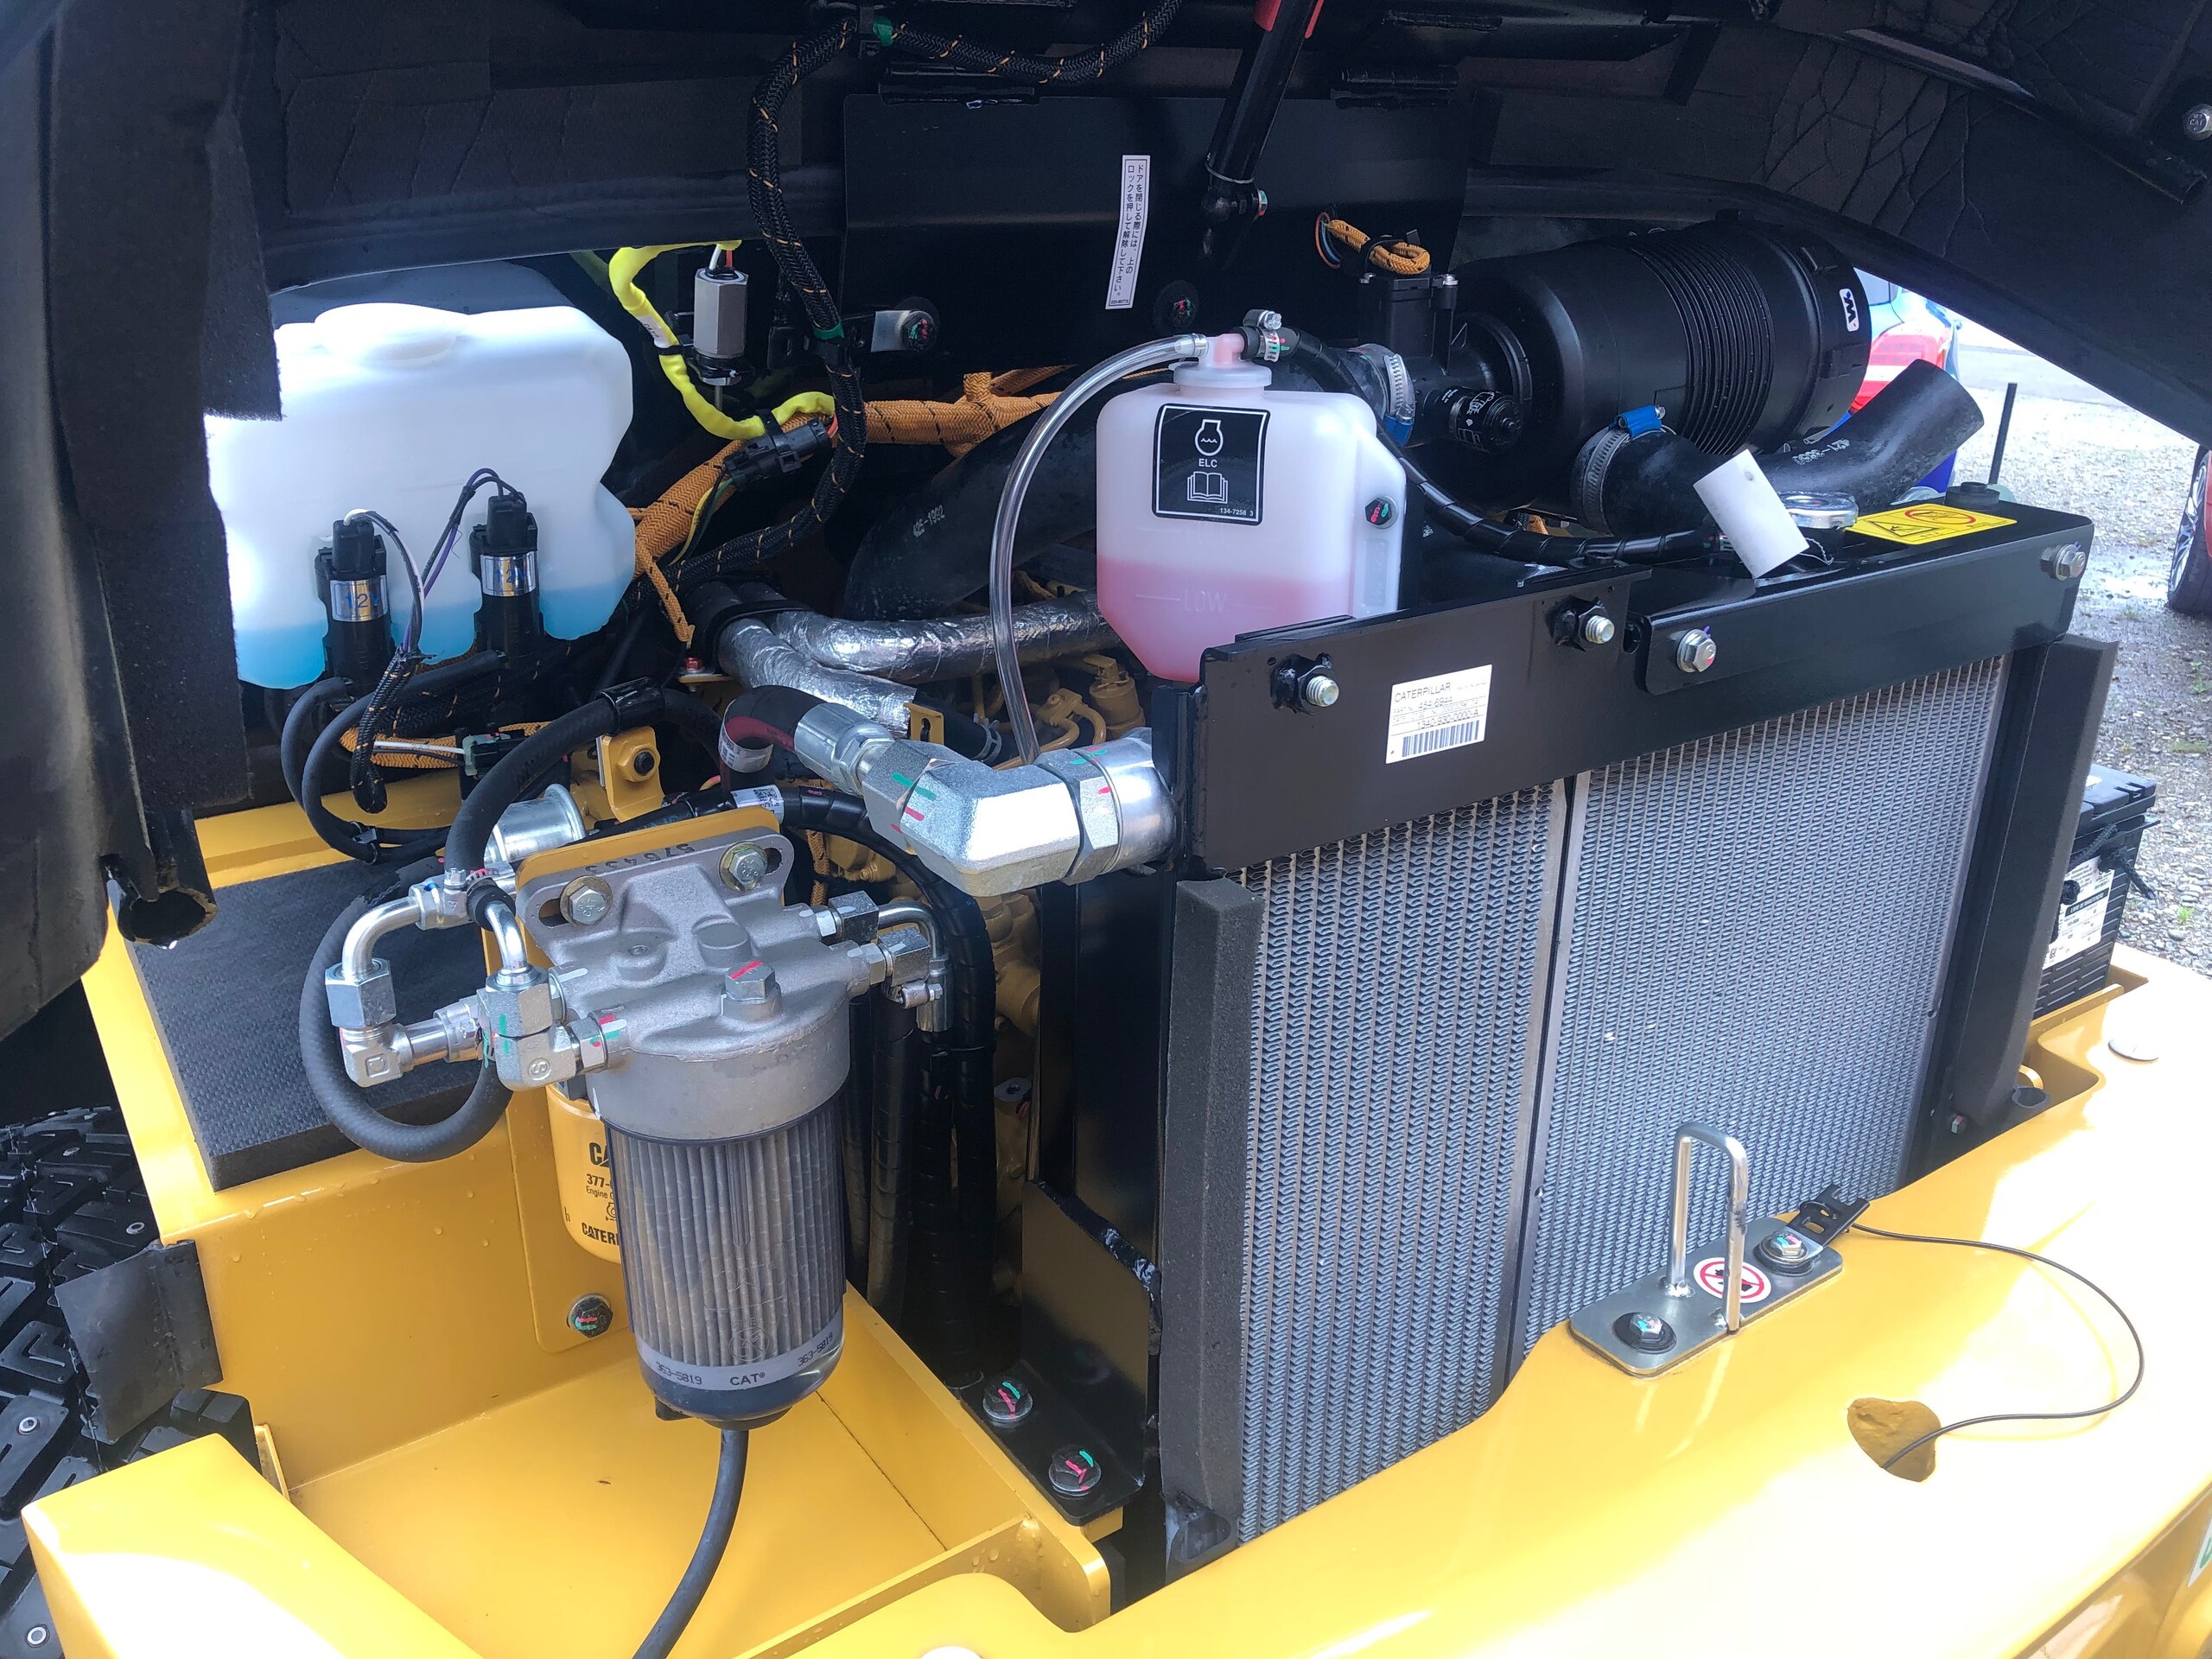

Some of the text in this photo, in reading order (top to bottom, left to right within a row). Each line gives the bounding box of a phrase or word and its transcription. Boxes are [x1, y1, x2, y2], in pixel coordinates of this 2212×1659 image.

[1198, 459, 1217, 467] ELC
[1219, 507, 1247, 516] 134-7258
[1185, 588, 1229, 613] LOW
[1395, 682, 1451, 702] CATERPILLAR
[589, 1141, 610, 1167] CA
[586, 1185, 607, 1198] Engine
[798, 1332, 833, 1367] 363-5819
[656, 1361, 702, 1385] 363-5819
